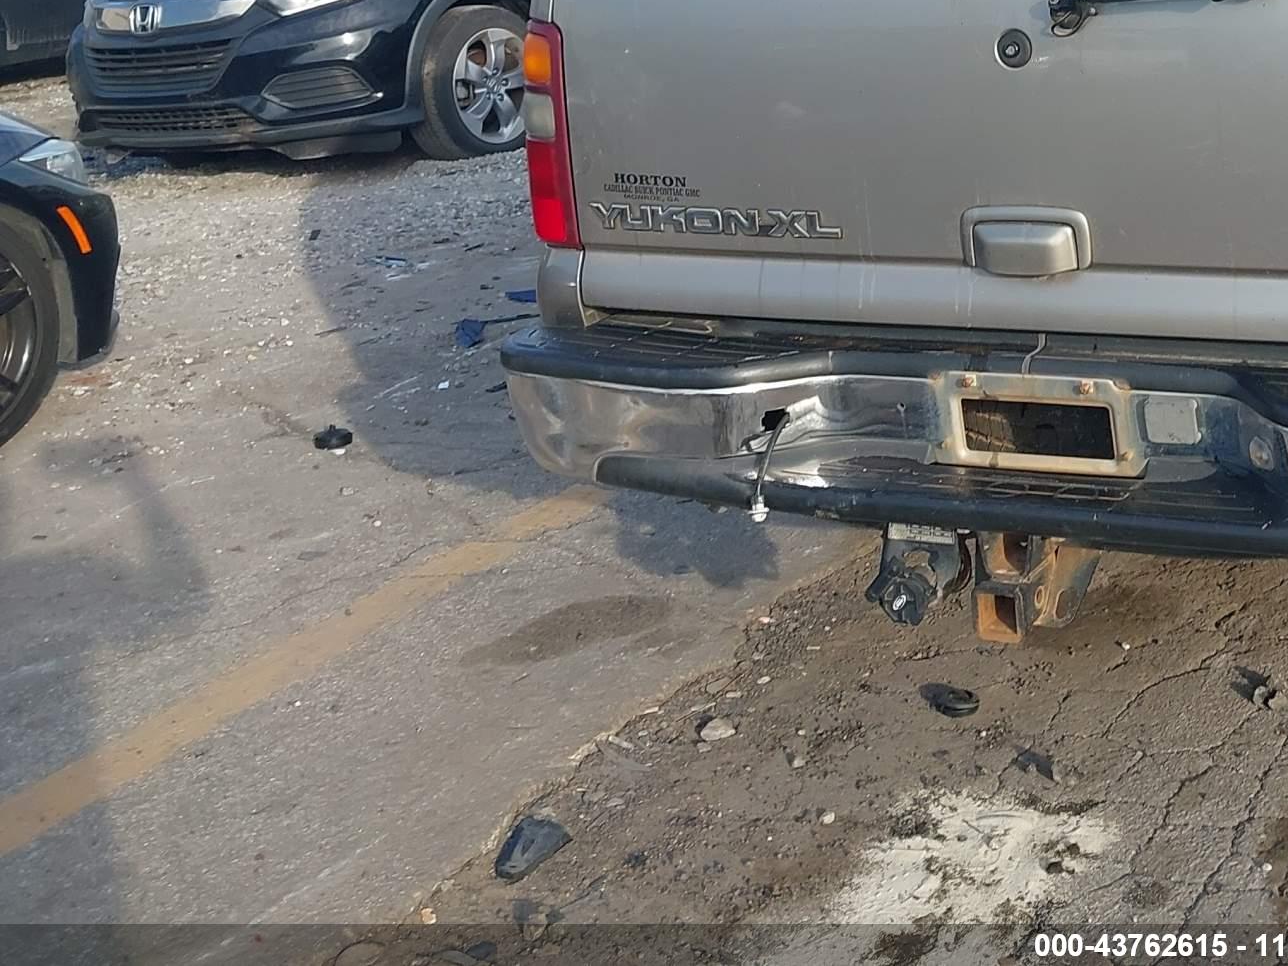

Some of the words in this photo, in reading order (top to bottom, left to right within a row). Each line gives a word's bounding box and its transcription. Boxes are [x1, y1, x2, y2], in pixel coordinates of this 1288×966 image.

[613, 173, 687, 188] HORTON
[604, 183, 634, 194] CADILLAC
[656, 186, 684, 197] PONTIAC
[685, 188, 700, 198] GMC
[589, 201, 760, 237] YUKON
[766, 209, 844, 240] XL
